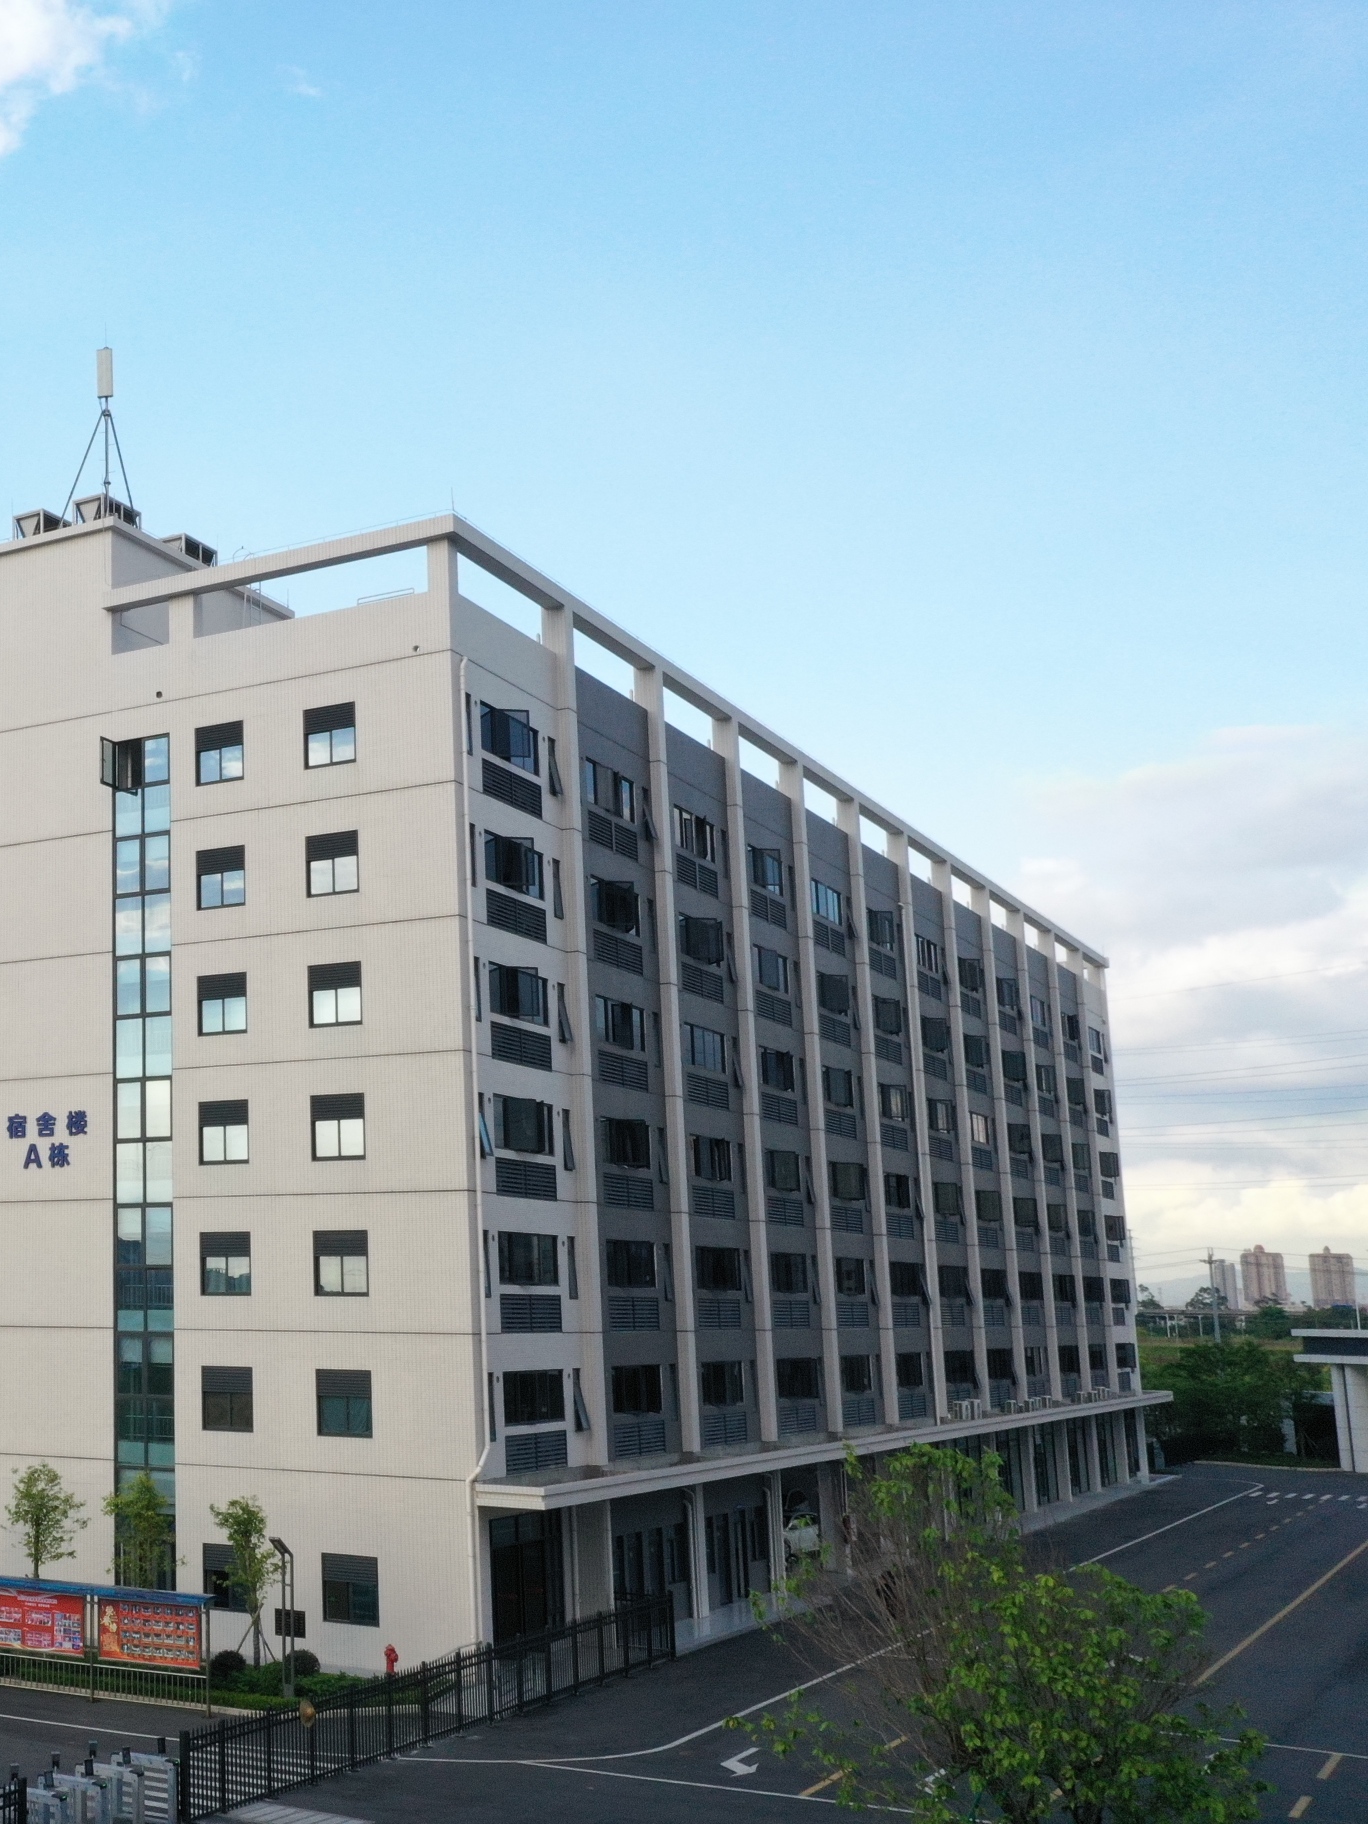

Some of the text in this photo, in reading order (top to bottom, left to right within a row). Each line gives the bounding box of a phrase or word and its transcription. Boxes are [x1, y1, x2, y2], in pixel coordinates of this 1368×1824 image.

[7, 1110, 88, 1139] 宿舍楼
[23, 1142, 70, 1169] A栋
